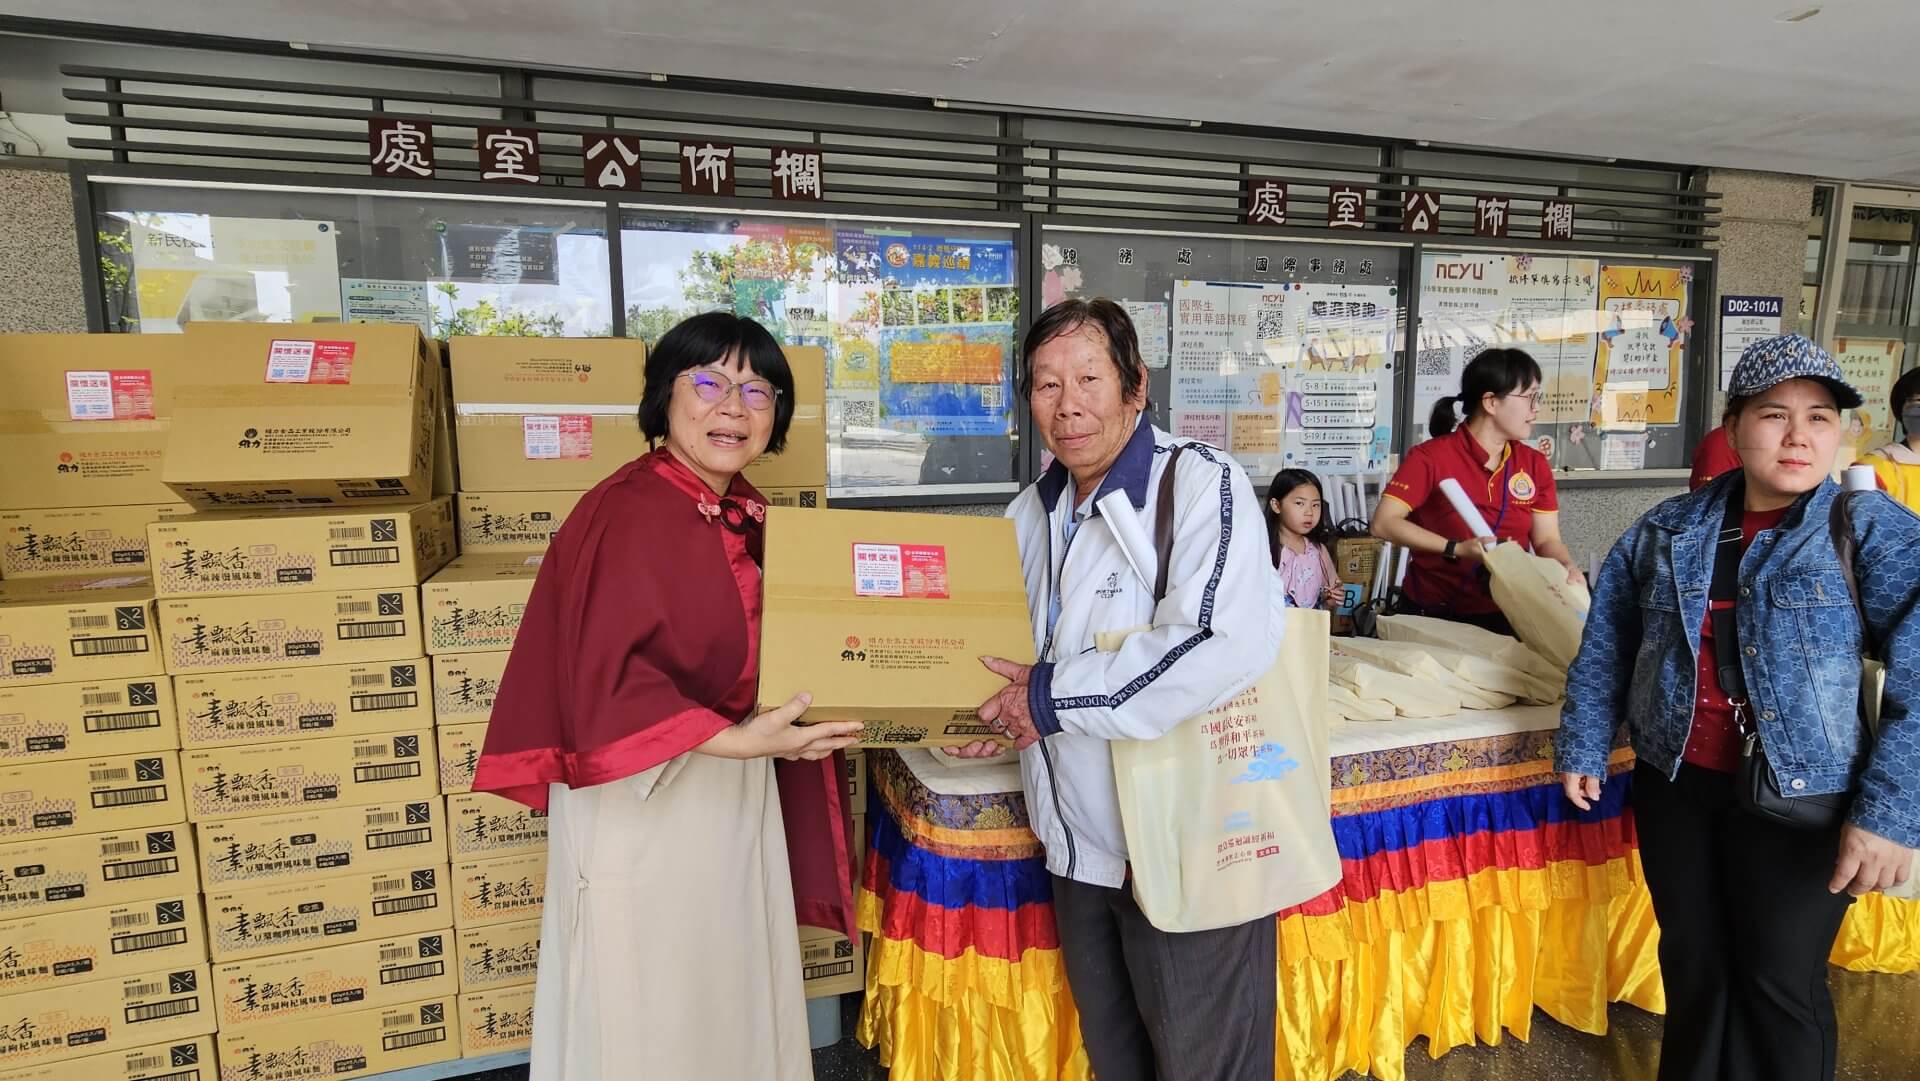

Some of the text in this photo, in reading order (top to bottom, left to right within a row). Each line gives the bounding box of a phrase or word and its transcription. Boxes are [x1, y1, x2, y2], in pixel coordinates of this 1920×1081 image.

[372, 121, 821, 198] 處室公佈欄
[1249, 181, 1574, 239] 處室公佈欄
[1063, 248, 1192, 264] 總務處
[1255, 256, 1373, 275] 國際事務處
[1728, 299, 1779, 313] D02-101A
[1221, 479, 1232, 502] PARIS
[802, 499, 808, 507] 3
[385, 520, 394, 530] 2
[472, 513, 532, 539] 素飄香
[375, 530, 384, 541] 3
[1217, 523, 1232, 567] LONDON
[170, 547, 249, 580] 素飄香
[392, 594, 401, 604] 2
[1202, 588, 1215, 616] PARIS
[1344, 590, 1355, 609] B
[133, 607, 143, 618] 2
[382, 604, 390, 615] 3
[120, 618, 130, 630] 3
[440, 606, 508, 637] 素飄香
[181, 622, 258, 655] 素飄香
[1167, 634, 1207, 664] LONDON
[405, 666, 414, 676] 2
[395, 676, 404, 687] 3
[1126, 677, 1150, 695] PARIS
[145, 683, 155, 694] 2
[132, 693, 142, 705] 3
[1077, 696, 1109, 707] NDON
[196, 696, 272, 729] 素飄香
[408, 736, 417, 746] 2
[398, 746, 406, 757] 3
[152, 759, 162, 770] 2
[139, 769, 150, 781] 3
[202, 769, 277, 801] 素飄香
[419, 803, 428, 813] 2
[409, 813, 418, 824] 3
[464, 809, 532, 842] 素飄香
[163, 832, 174, 843] 2
[150, 842, 161, 854] 3
[216, 838, 291, 872] 素飄香
[425, 870, 433, 880] 2
[415, 880, 423, 891] 3
[468, 877, 535, 910] 素飄香
[173, 901, 183, 912] 2
[160, 912, 170, 924] 3
[225, 906, 299, 942] 素飄香
[433, 936, 441, 947] 2
[423, 946, 431, 958] 3
[471, 941, 537, 974] 素飄香
[184, 971, 194, 982] 2
[173, 982, 182, 994] 3
[232, 976, 306, 1012] 素飄香
[434, 1004, 442, 1014] 2
[424, 1014, 432, 1025] 3
[186, 1044, 196, 1055] 2
[175, 1055, 184, 1067] 3
[238, 1046, 309, 1081] 素飄香
